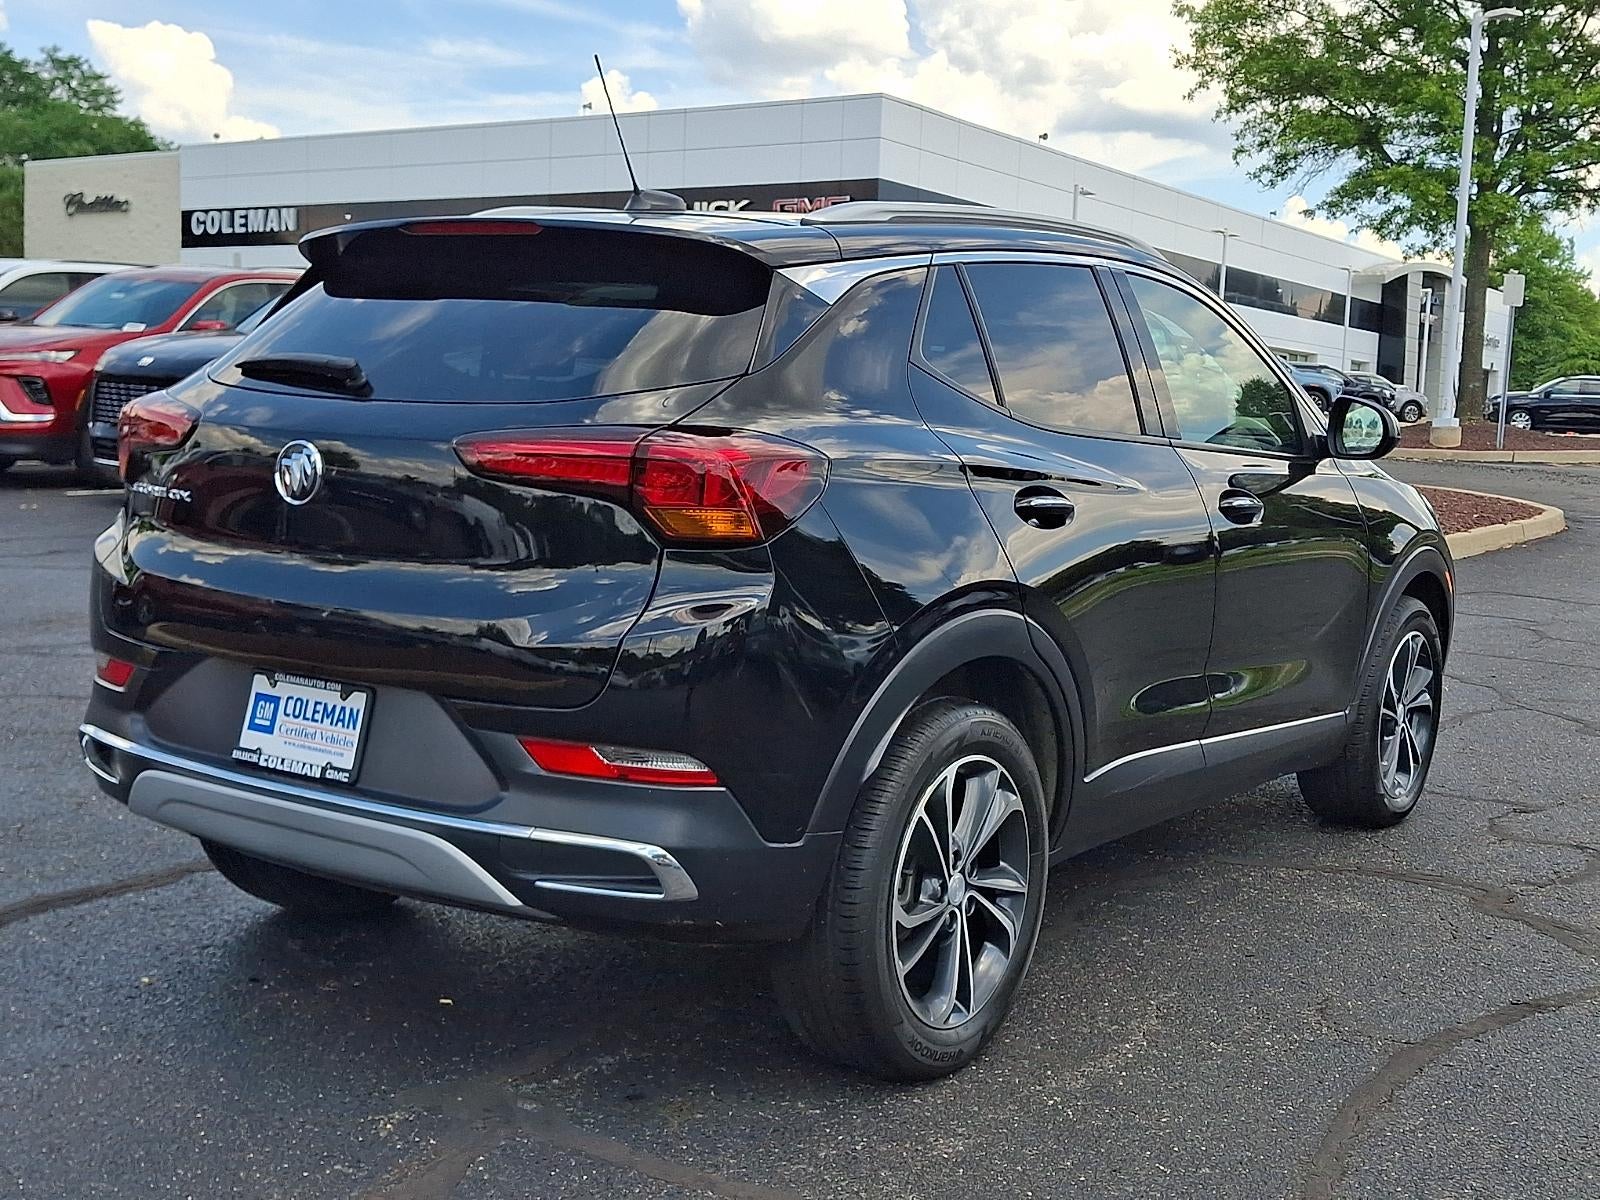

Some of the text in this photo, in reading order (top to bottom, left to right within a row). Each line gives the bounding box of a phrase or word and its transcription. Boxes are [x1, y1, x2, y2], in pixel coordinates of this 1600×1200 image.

[64, 192, 129, 216] Cadillac
[693, 199, 750, 212] ICK
[190, 207, 298, 235] COLEMAN
[257, 701, 274, 719] GM
[283, 696, 360, 731] COLEMAN
[279, 723, 354, 749] Certified Vehicles
[259, 755, 321, 778] COLEMAN
[326, 769, 349, 782] GMC
